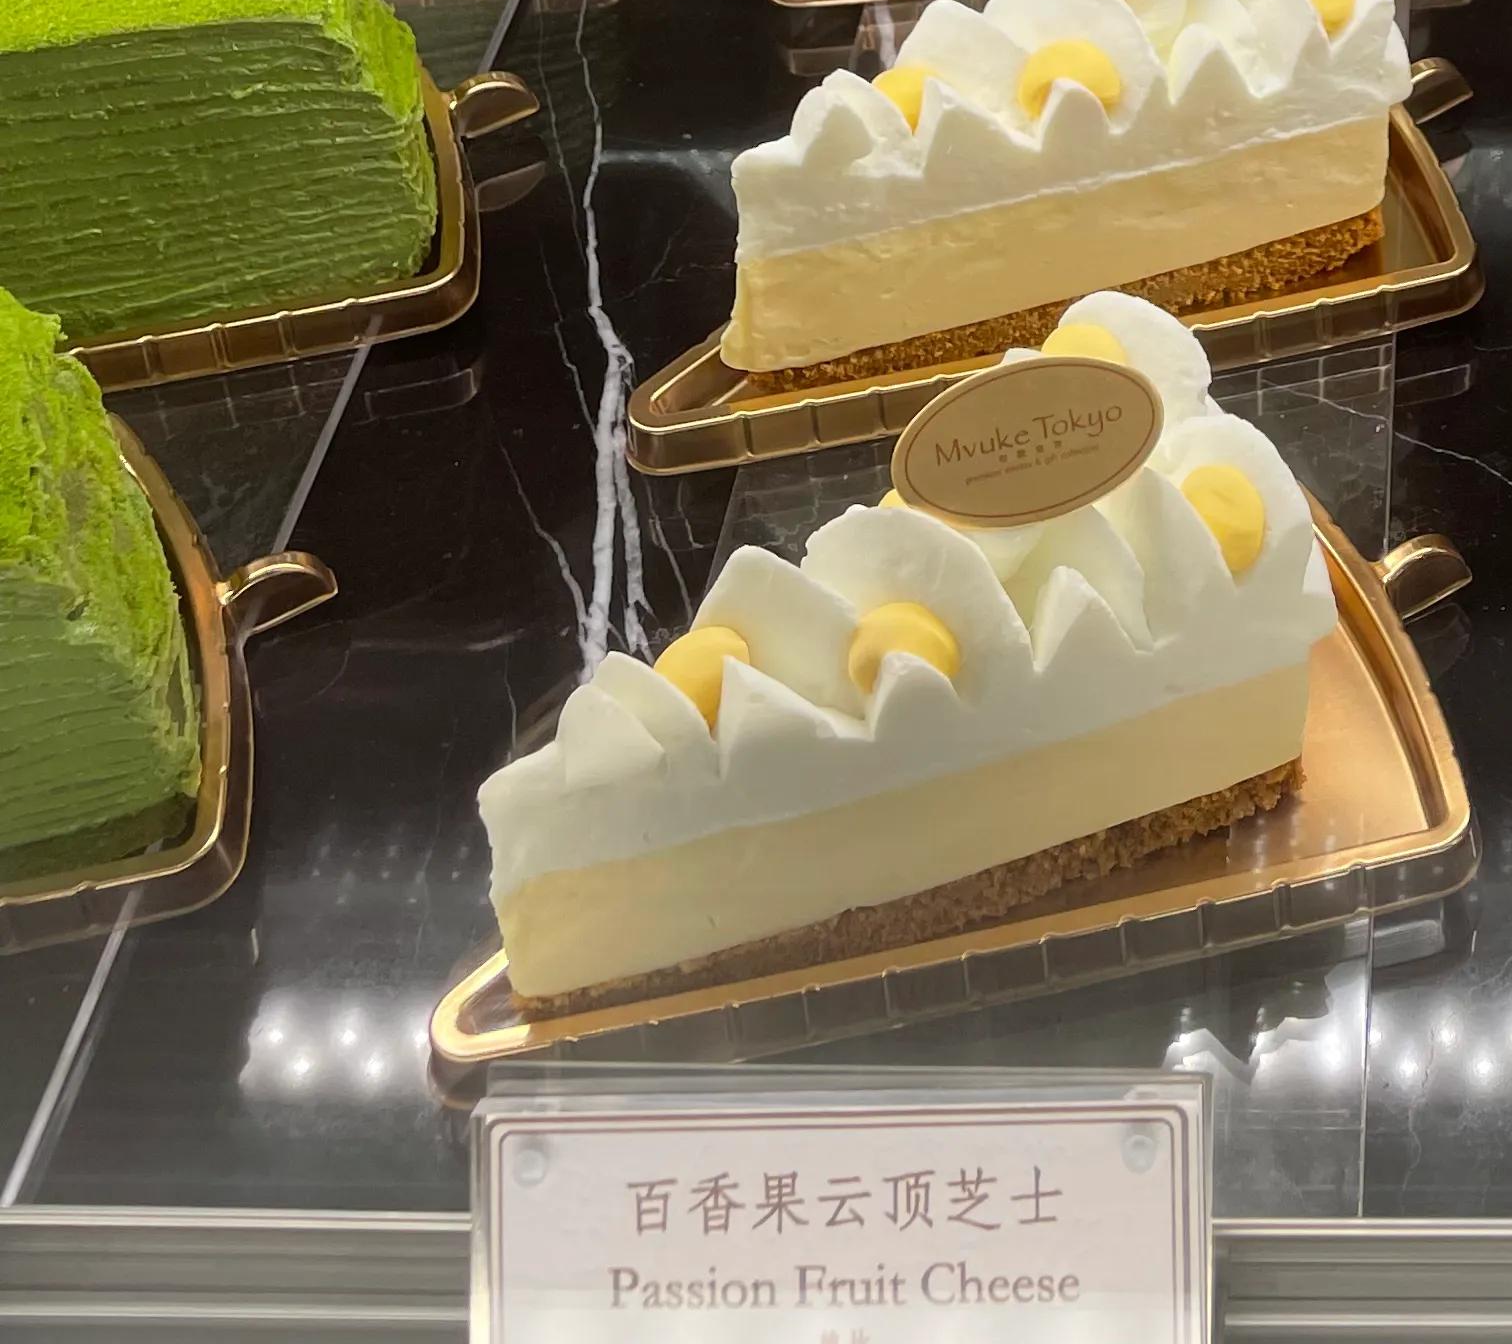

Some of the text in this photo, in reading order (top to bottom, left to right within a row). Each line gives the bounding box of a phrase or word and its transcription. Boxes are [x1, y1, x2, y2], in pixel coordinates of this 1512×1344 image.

[935, 428, 1030, 467] Mvuke
[1033, 405, 1122, 440] Tokyo
[626, 1165, 1063, 1236] 百香果云顶芝士
[609, 1261, 1080, 1309] Passion Fruit Cheese
